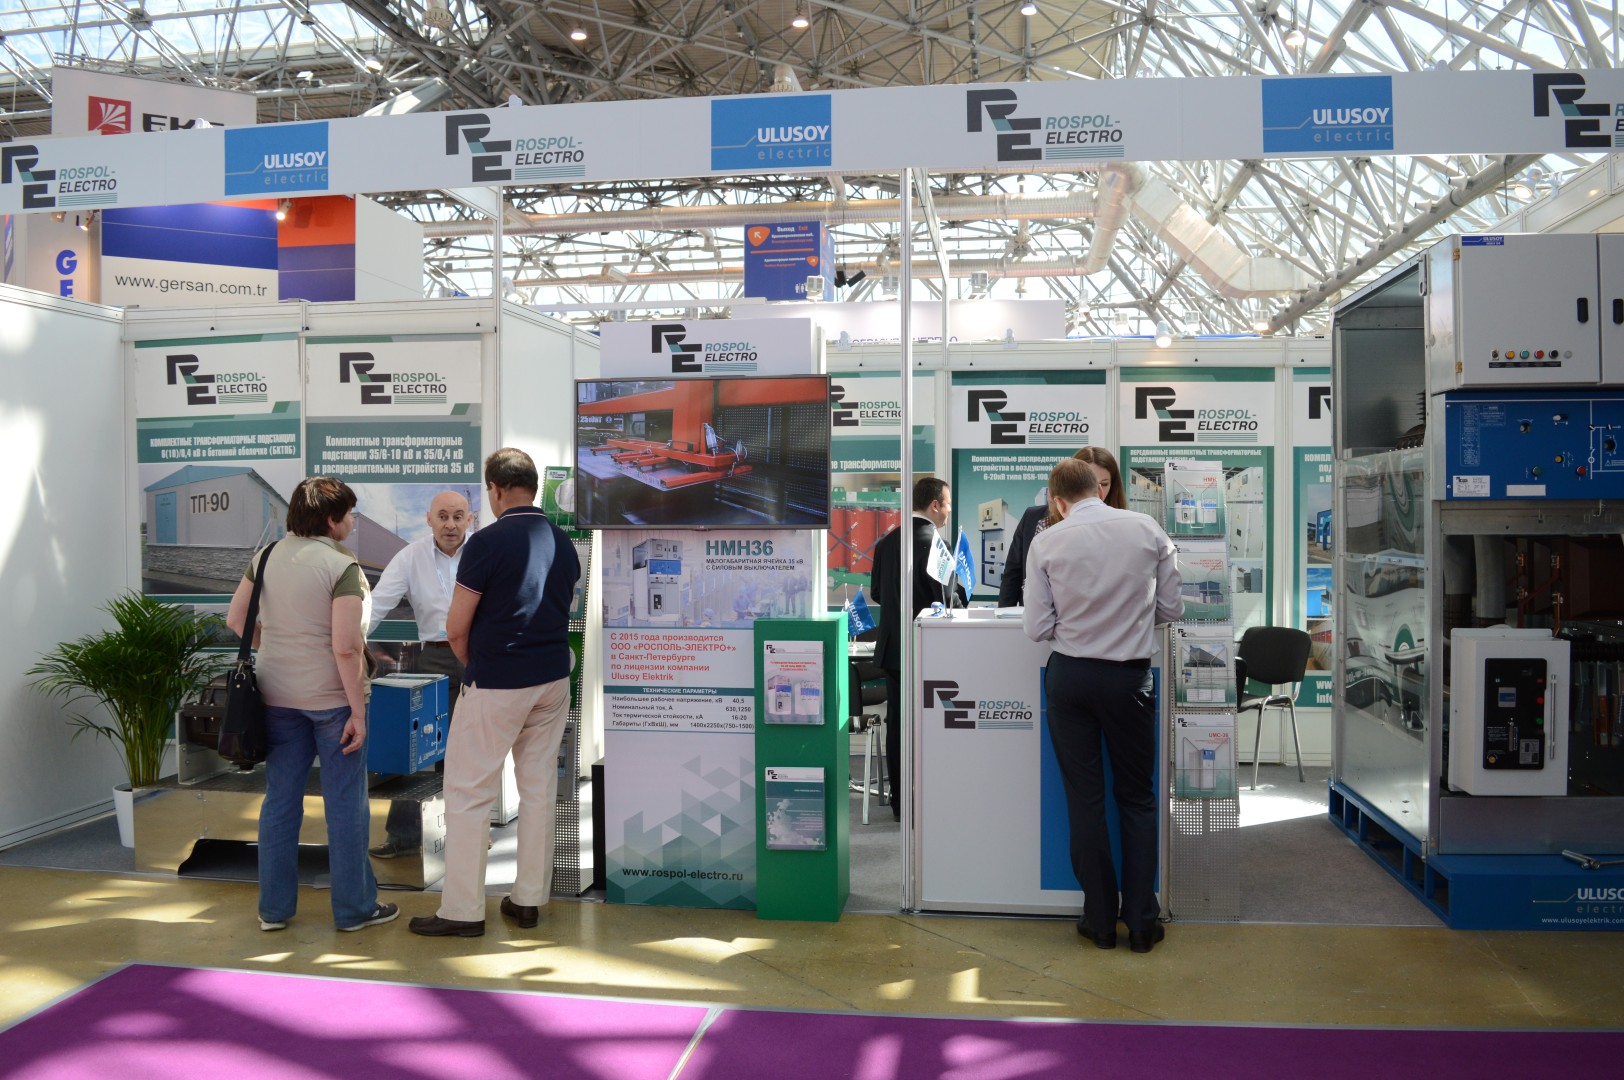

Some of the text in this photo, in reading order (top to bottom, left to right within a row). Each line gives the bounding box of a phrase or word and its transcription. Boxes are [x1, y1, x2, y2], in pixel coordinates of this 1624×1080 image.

[1045, 115, 1120, 130] ROSPOL-
[1313, 107, 1389, 125] ULUSOY
[757, 125, 830, 143] ULUSOY
[1045, 129, 1122, 145] ELECTRO
[1314, 129, 1391, 143] electric
[515, 136, 583, 151] ROSPOL-
[515, 150, 584, 166] ELECTRO
[758, 145, 830, 160] electric
[264, 151, 327, 169] ULUSOY
[59, 166, 116, 180] ROSPOL-
[264, 171, 327, 185] electric
[59, 179, 117, 193] ELECTRO
[114, 273, 268, 297] www.gersan.com.tr
[705, 342, 757, 353] ROSPOL-
[705, 352, 757, 362] ELECTRO
[216, 372, 266, 383] ROSPOL-
[392, 372, 446, 383] ROSPOL-
[216, 383, 268, 394] ELECTRO
[393, 383, 447, 394] ELECTRO
[1028, 412, 1088, 422] ROSPOL-
[1198, 409, 1256, 420] ROSPOL-
[1028, 423, 1089, 434] ELECTRO
[1198, 420, 1258, 431] ELECTRO
[326, 434, 463, 448] Комплектные трансформаторные
[322, 448, 464, 462] подстанции 35/6-10 кВ и 35/0,4 кВ
[314, 462, 474, 475] и распределительные устройства 35 кВ
[1015, 464, 1052, 472] воздушной
[190, 491, 230, 514] ТП-90
[633, 643, 736, 652] «РОСПОЛЬ-ЭЛЕКТРО+»
[618, 654, 696, 662] Санкт-Петербурге
[611, 673, 640, 682] Ulusoy
[978, 700, 1031, 710] ROSPOL-
[978, 710, 1032, 720] ELECTRO
[622, 868, 744, 882] www.rospol-electro.ru
